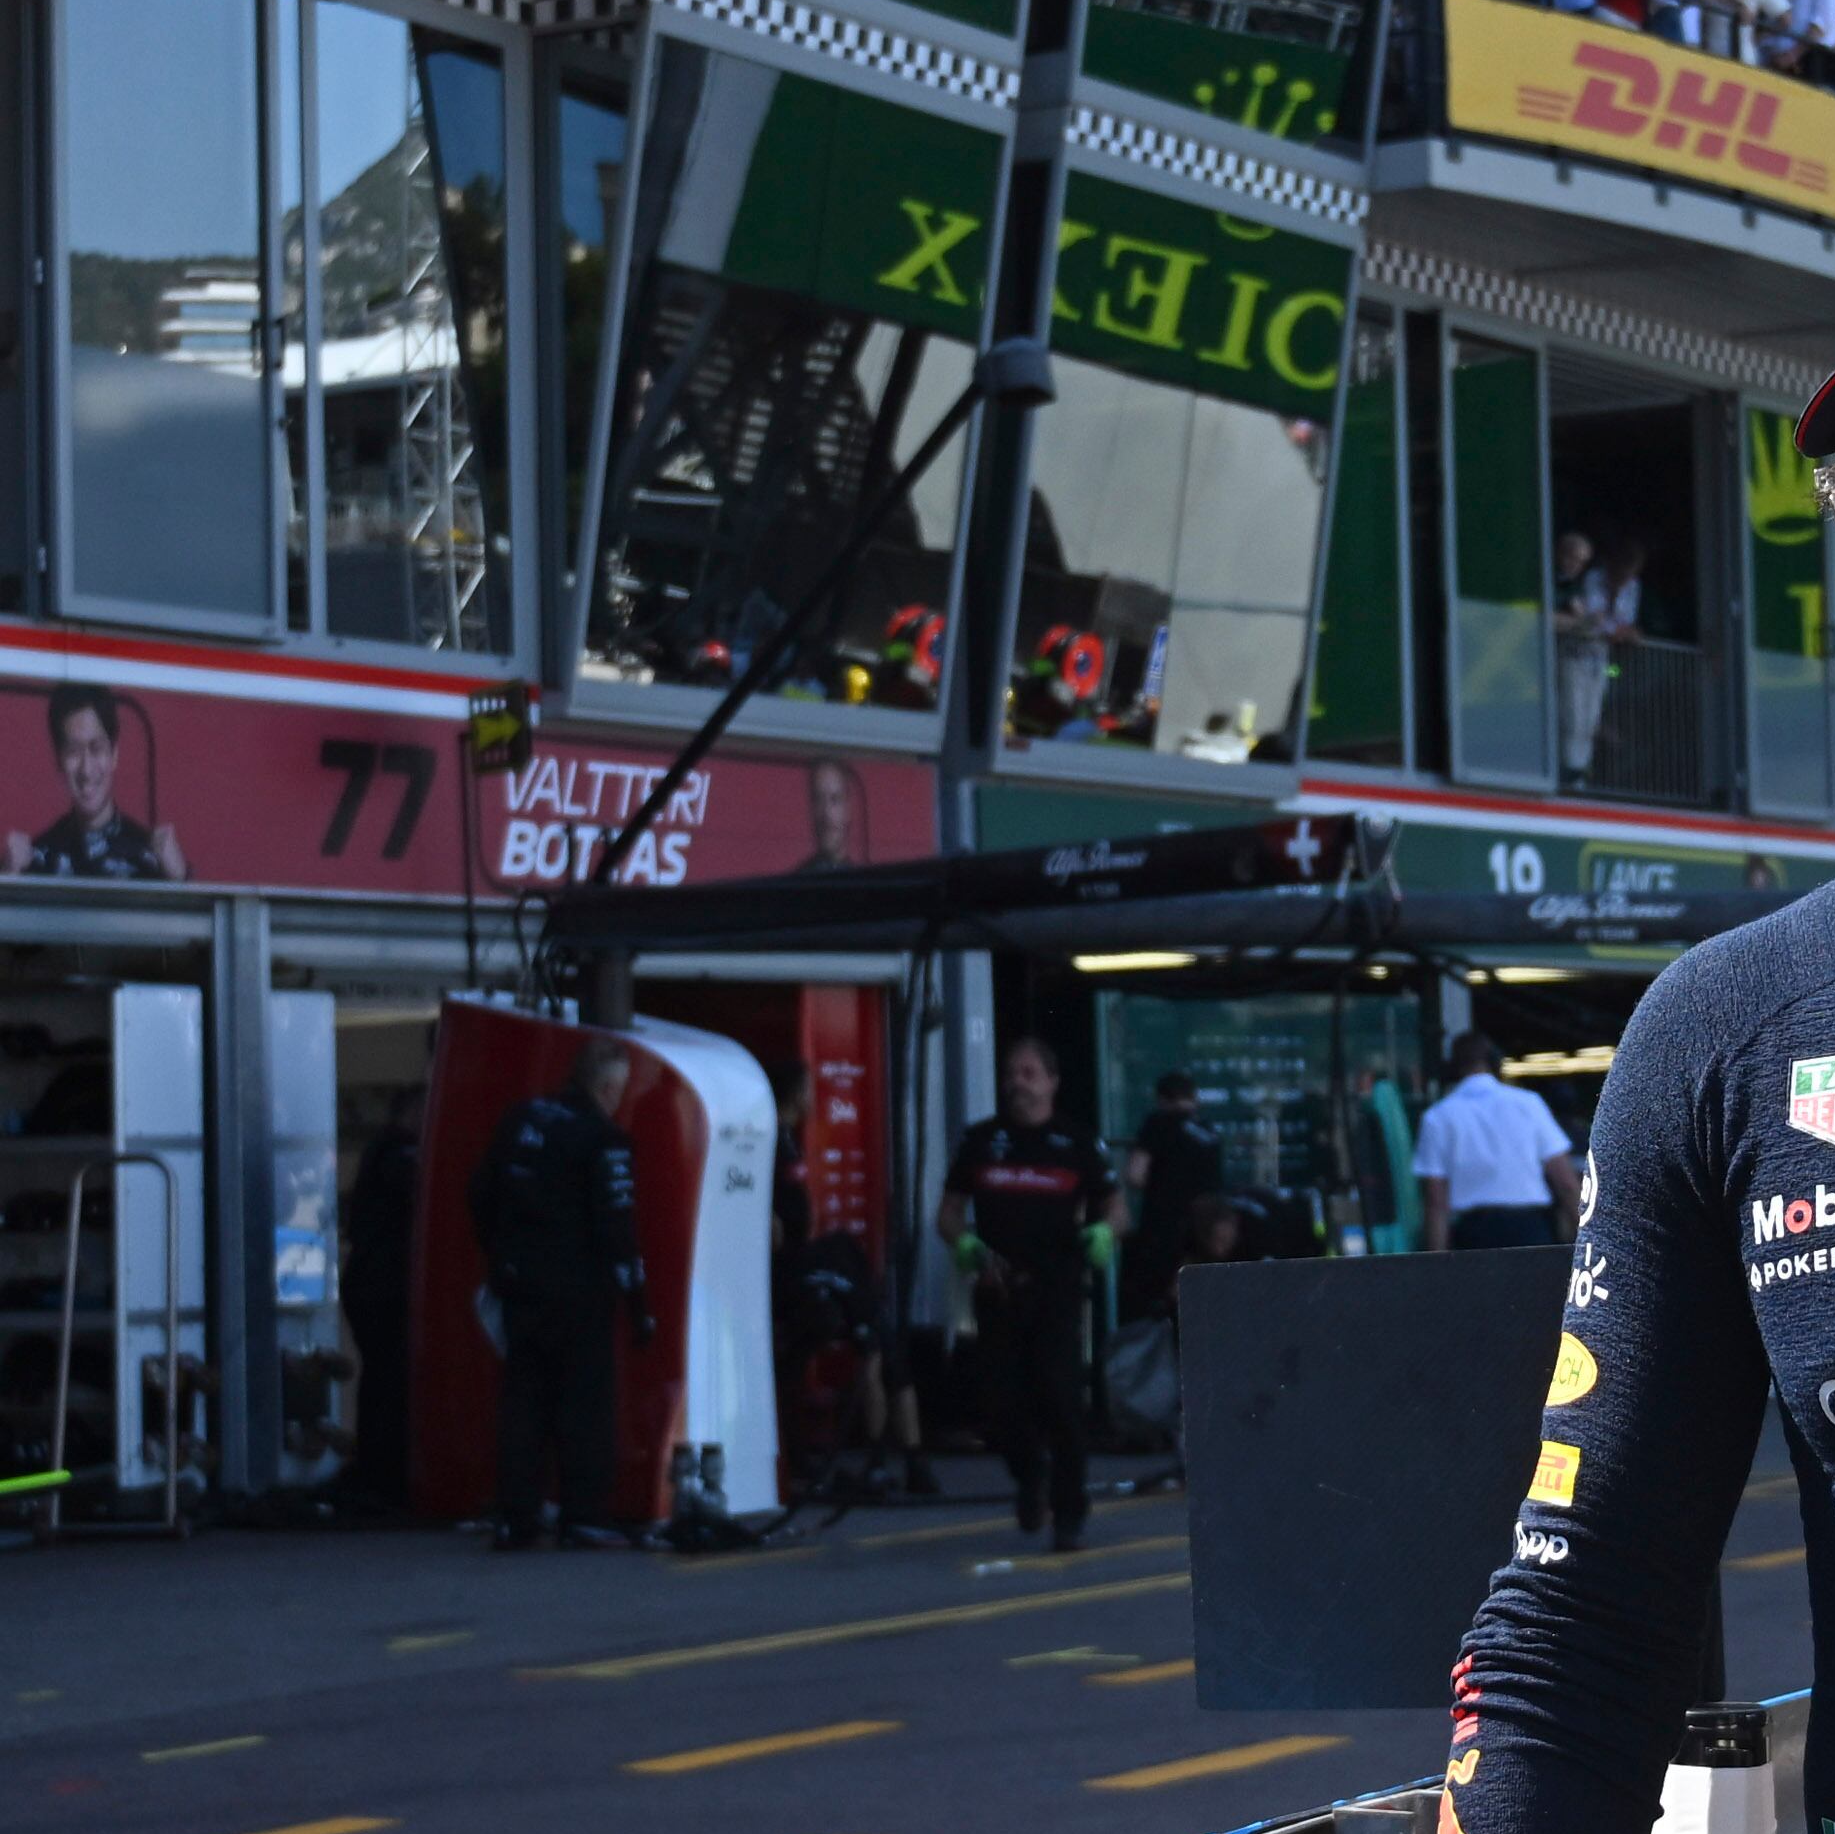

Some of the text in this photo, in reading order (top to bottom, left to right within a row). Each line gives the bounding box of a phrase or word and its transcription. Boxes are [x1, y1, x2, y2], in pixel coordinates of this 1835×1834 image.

[1571, 42, 1794, 179] DHL
[320, 739, 437, 861] 77
[500, 817, 692, 887] BOTAS
[1487, 841, 1546, 895] 10
